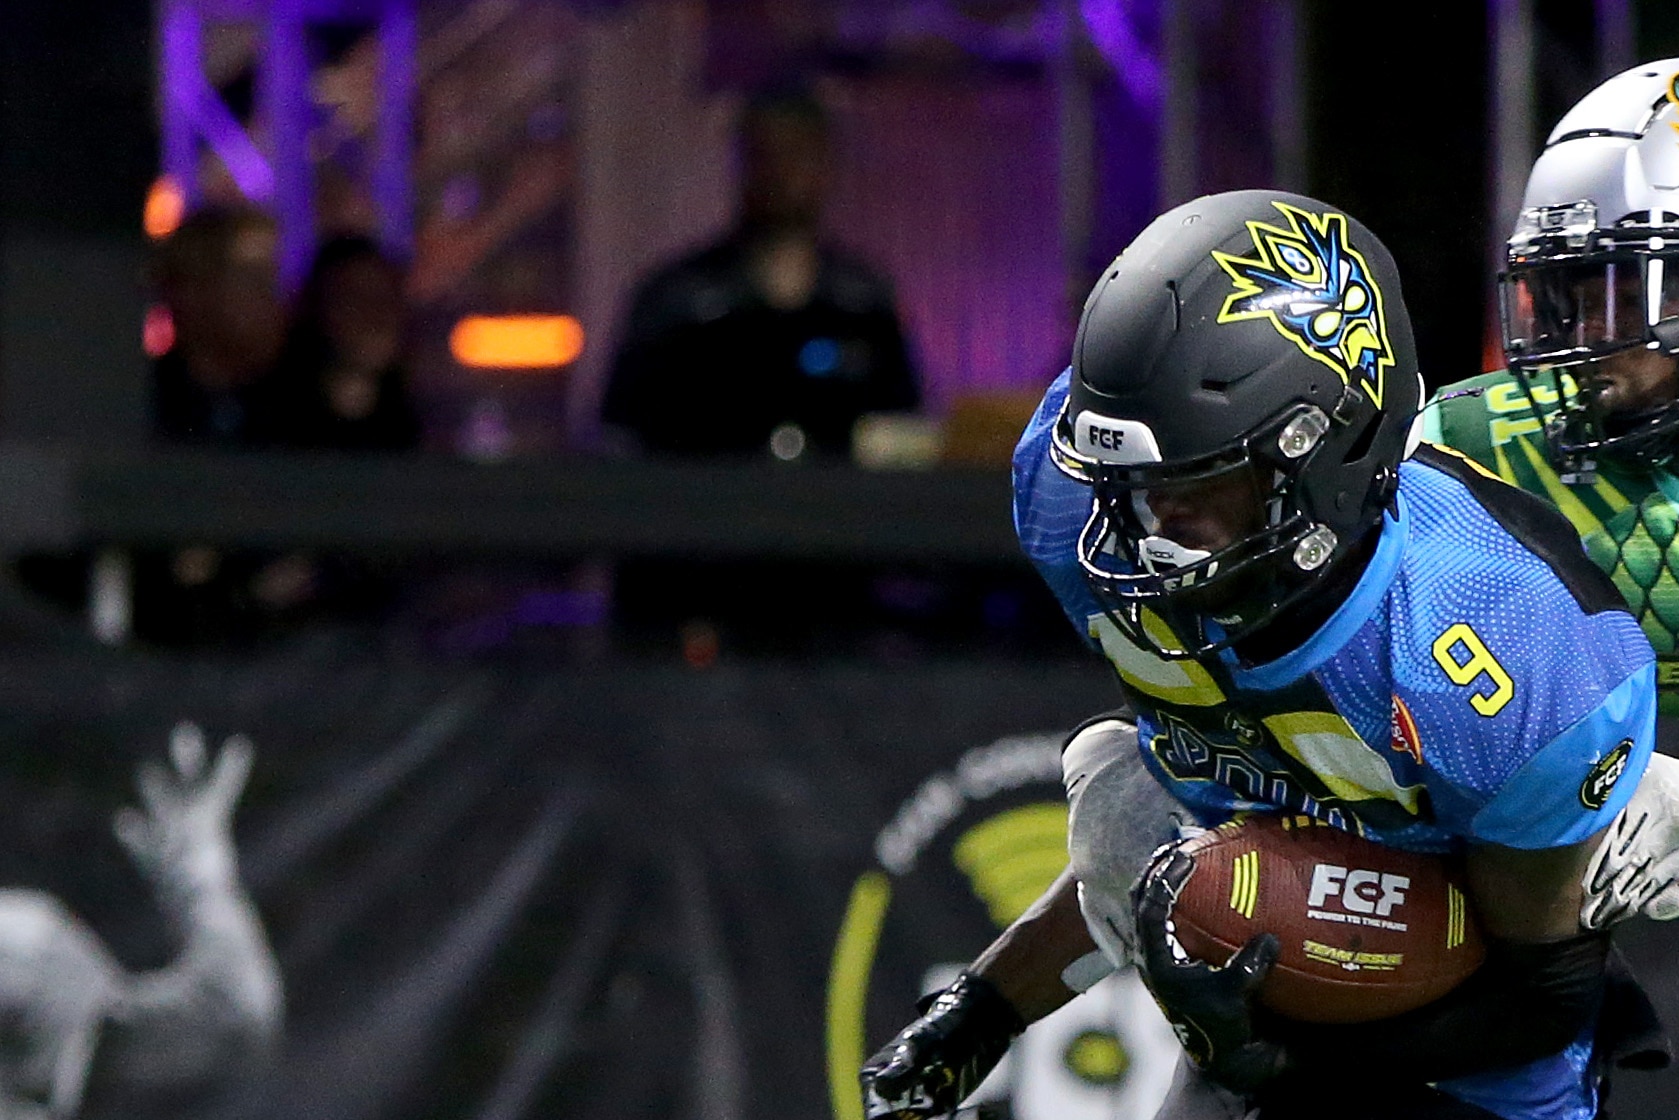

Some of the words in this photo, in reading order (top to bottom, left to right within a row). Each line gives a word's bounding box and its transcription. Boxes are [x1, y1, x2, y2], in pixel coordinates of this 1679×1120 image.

[1089, 425, 1124, 450] FCF
[1432, 622, 1515, 717] 9
[1593, 753, 1627, 795] FCF
[1307, 863, 1411, 916] FCF
